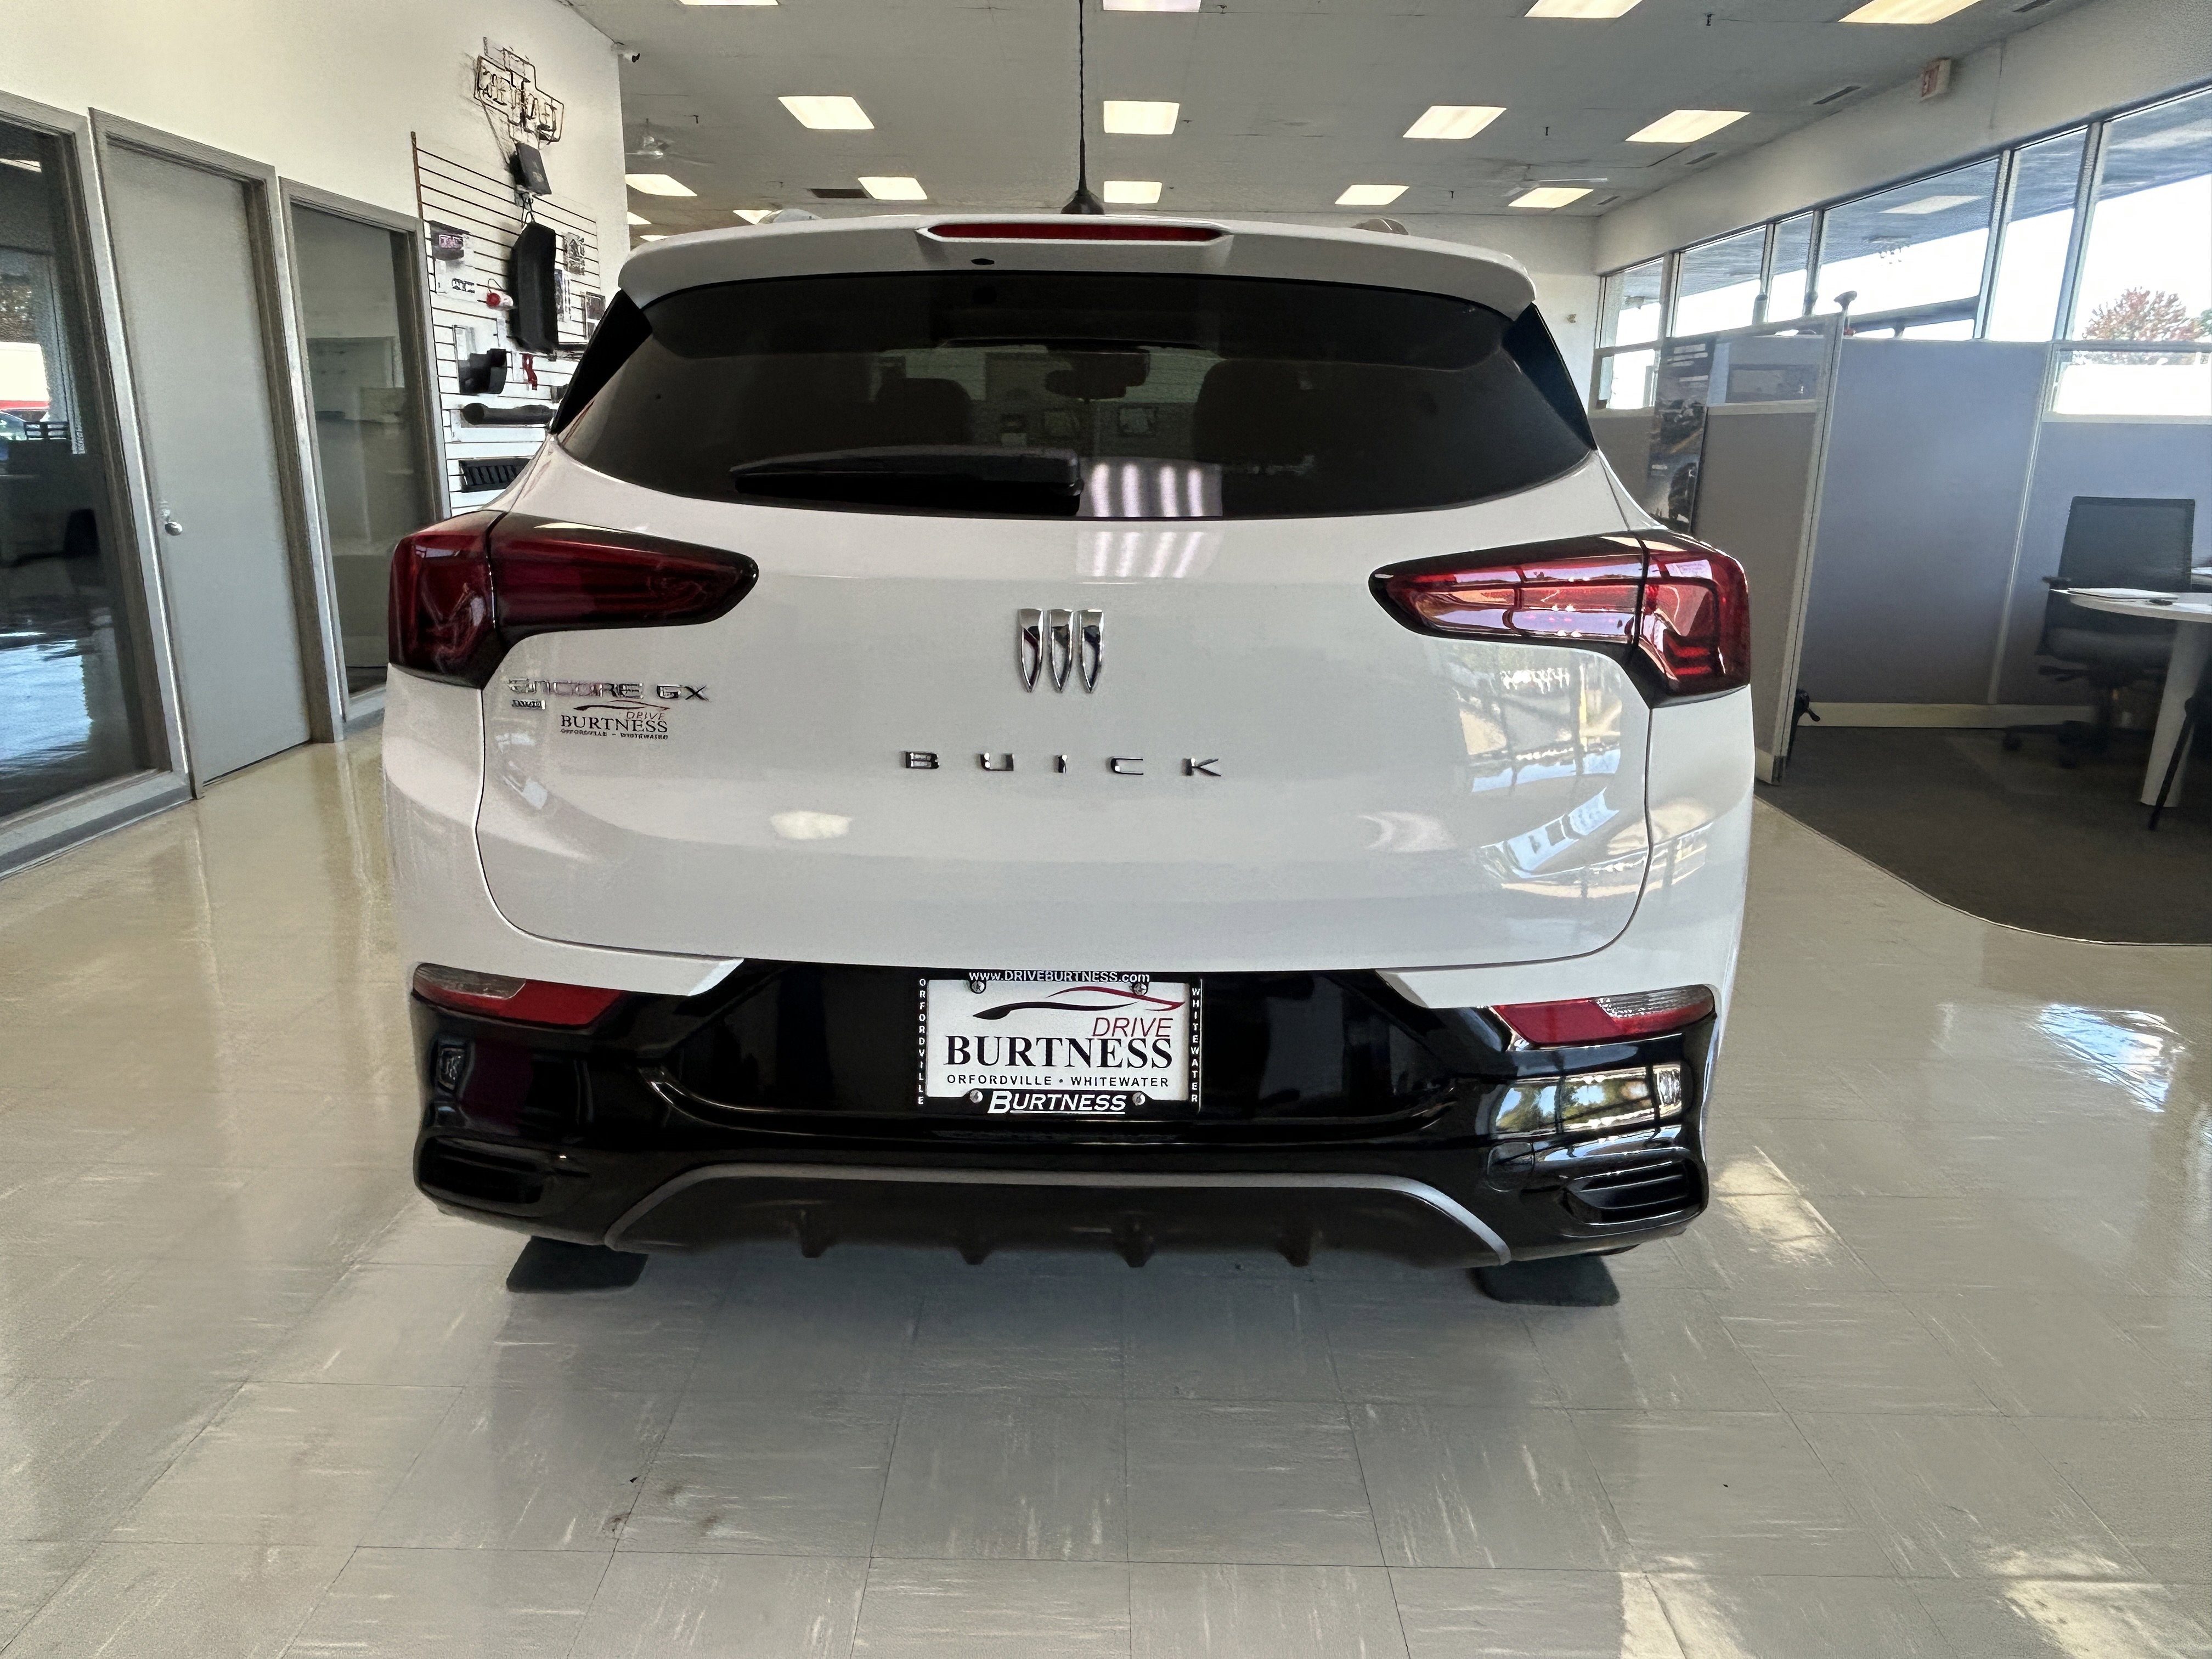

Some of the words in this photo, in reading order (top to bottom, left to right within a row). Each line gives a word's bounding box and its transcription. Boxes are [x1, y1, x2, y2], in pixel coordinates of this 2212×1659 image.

[656, 684, 709, 702] GX
[561, 715, 668, 733] BURTNESS
[626, 711, 665, 720] DRIVE
[904, 751, 1221, 776] BUICK
[969, 970, 1150, 983] www.DRIVEBURTNESS.com
[1092, 1017, 1173, 1037] DRIVE
[918, 978, 927, 1105] ORFORDVILLE
[1190, 988, 1201, 1103] WHITEWATER
[943, 1035, 1173, 1069] BURTNESS
[947, 1074, 1052, 1085] ORFORDVILLE
[1070, 1076, 1169, 1087] WHITEWATER
[987, 1091, 1127, 1114] BURTNESS
